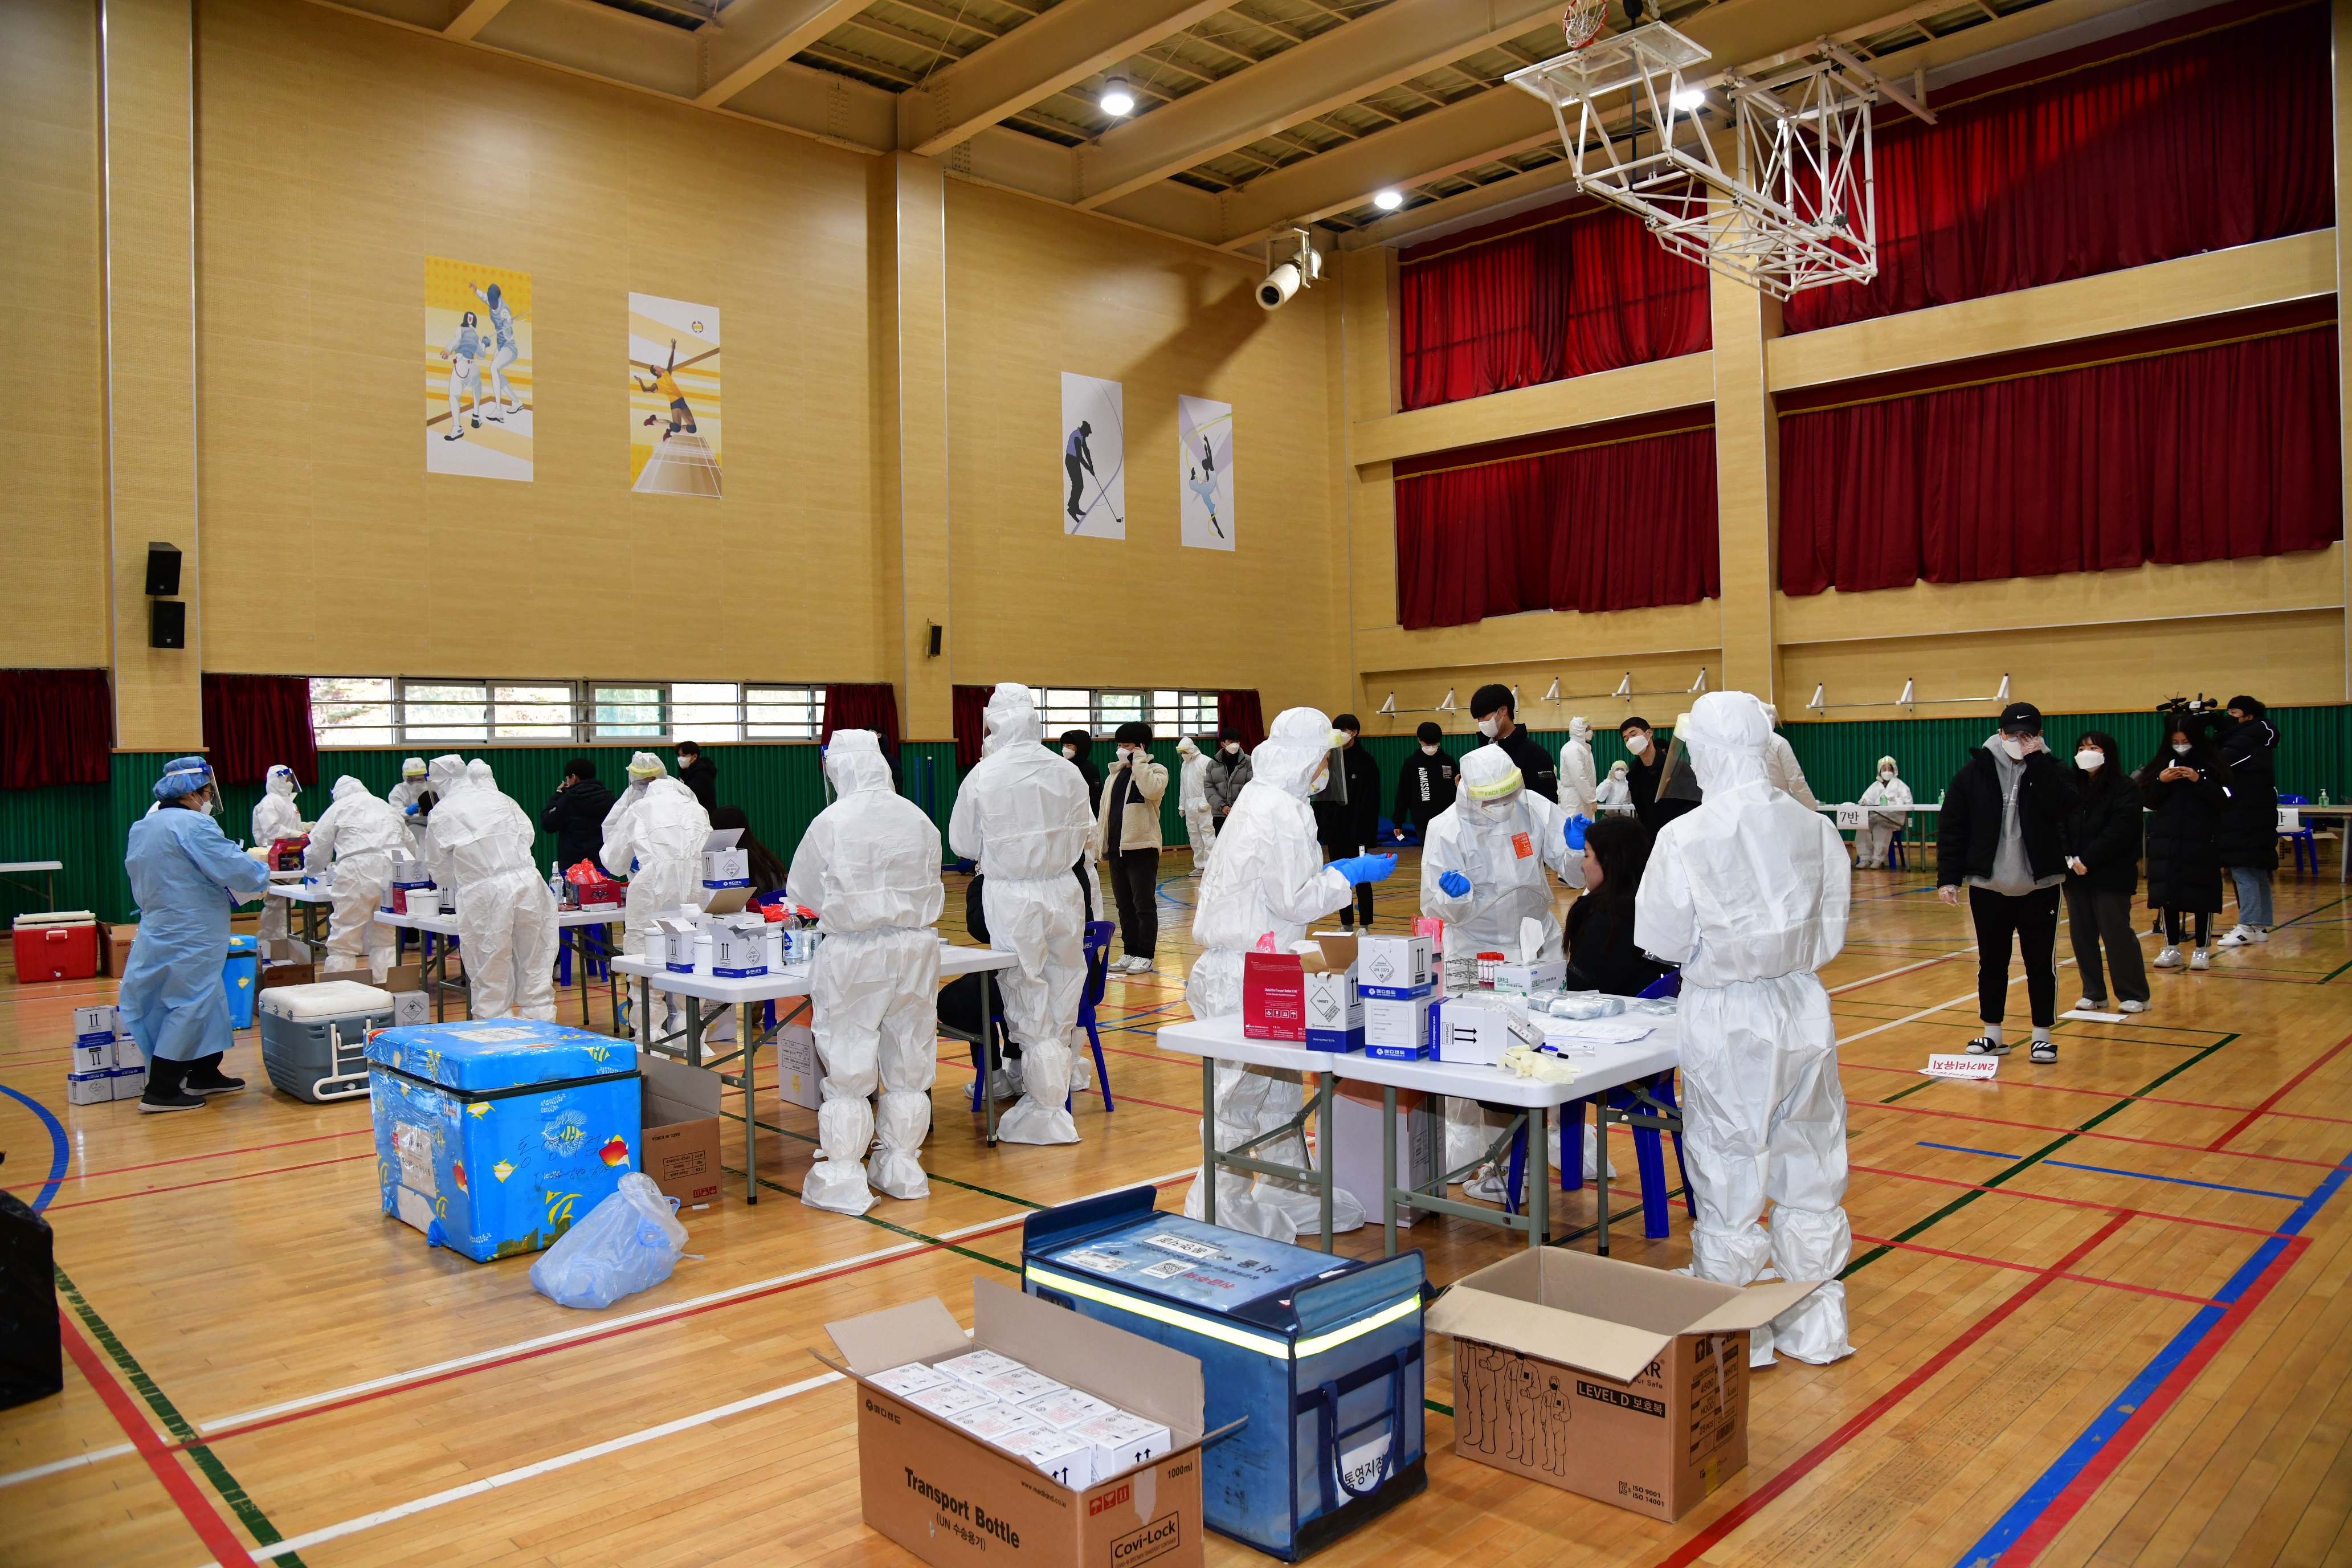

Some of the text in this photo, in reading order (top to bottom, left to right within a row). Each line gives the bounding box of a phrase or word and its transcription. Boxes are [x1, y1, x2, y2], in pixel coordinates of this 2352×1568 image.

[1500, 781, 1517, 793] SHIELD
[1840, 811, 1859, 824] 7반
[1933, 1060, 1995, 1071] 2M거리유지
[518, 1134, 601, 1169] 통영지점
[1156, 1238, 1207, 1253] 통영지점
[1182, 1272, 1236, 1289] 취급주의
[1724, 1362, 1737, 1378] WHITE
[1647, 1380, 1663, 1389] Safe
[1701, 1378, 1714, 1393] 4500
[1579, 1382, 1663, 1415] LEVEL D 보호복
[1701, 1400, 1714, 1416] HOOD
[1700, 1419, 1714, 1435] 25PCS
[1167, 1462, 1193, 1479] 1000ml
[1345, 1453, 1383, 1489] 통영지점
[1021, 1480, 1067, 1508] www.mediland.co.kr
[1645, 1489, 1660, 1498] 9001
[1645, 1497, 1664, 1506] 14001
[905, 1467, 1020, 1549] Transport Bottle
[936, 1512, 986, 1551] (UN 수송용기)
[1114, 1520, 1176, 1558] Covi-Lock
[1129, 1552, 1144, 1564] SPECIMEN
[1144, 1545, 1161, 1558] TRANSPORT
[1161, 1537, 1177, 1549] CONTAINER
